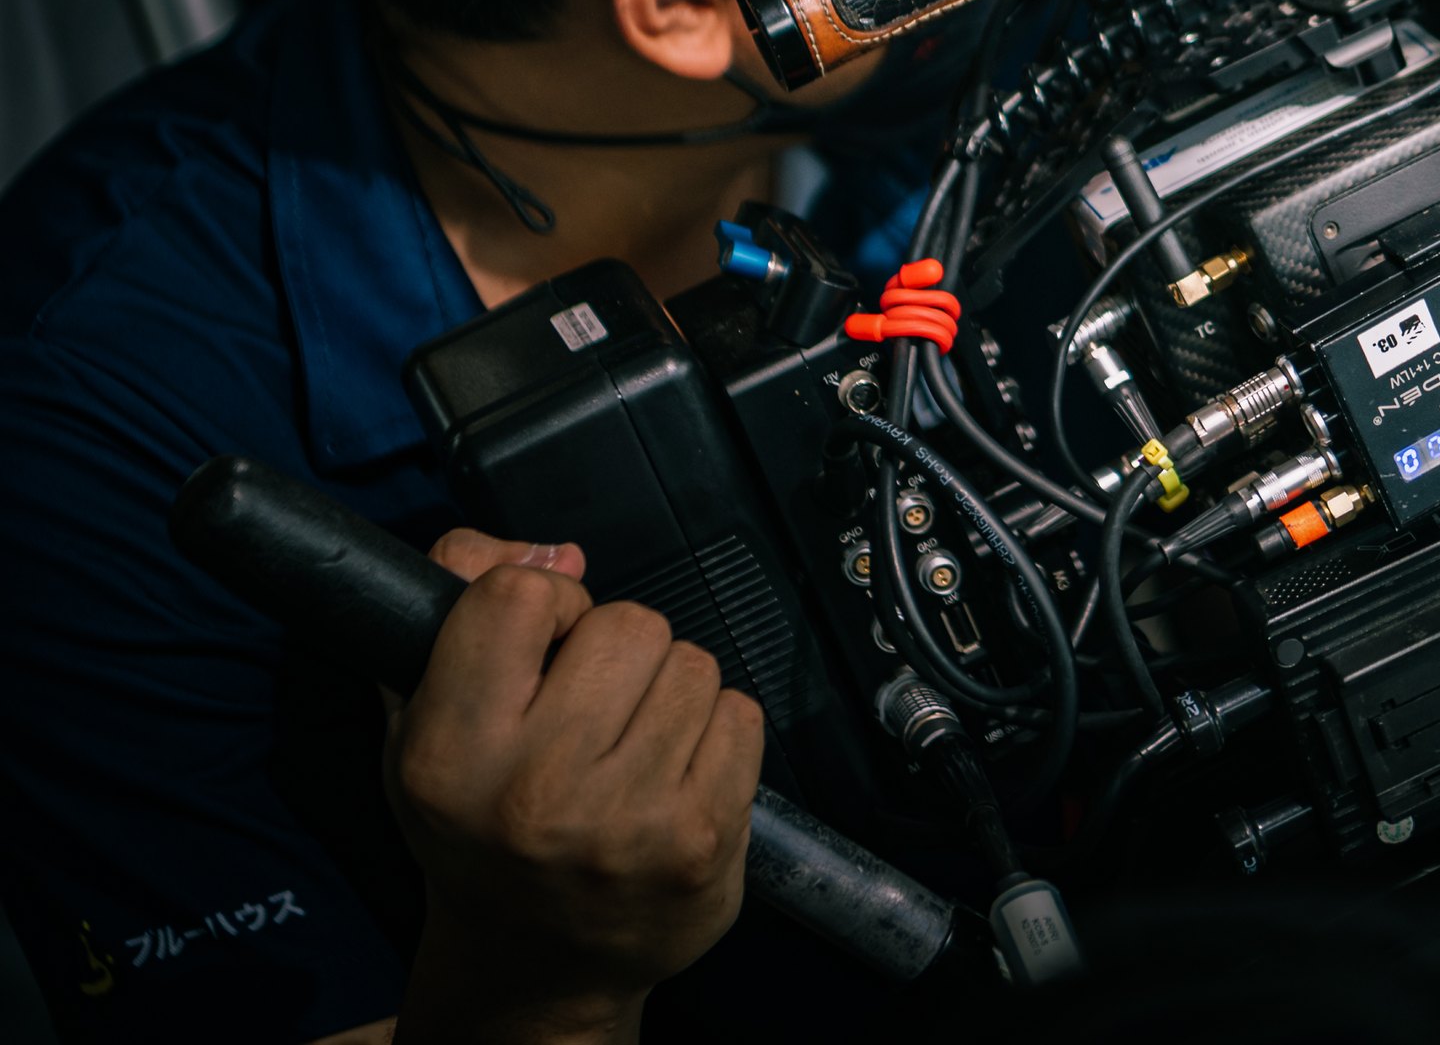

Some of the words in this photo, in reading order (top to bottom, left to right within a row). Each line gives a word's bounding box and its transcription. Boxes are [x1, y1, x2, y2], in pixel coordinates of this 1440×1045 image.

[1194, 321, 1215, 339] TC
[858, 351, 880, 368] GND
[1390, 359, 1431, 389] 1+1LW
[914, 446, 955, 486] RoHS
[906, 473, 926, 487] GN
[838, 525, 864, 544] GND
[916, 537, 938, 554] GND
[126, 890, 305, 967] ブルーハウス
